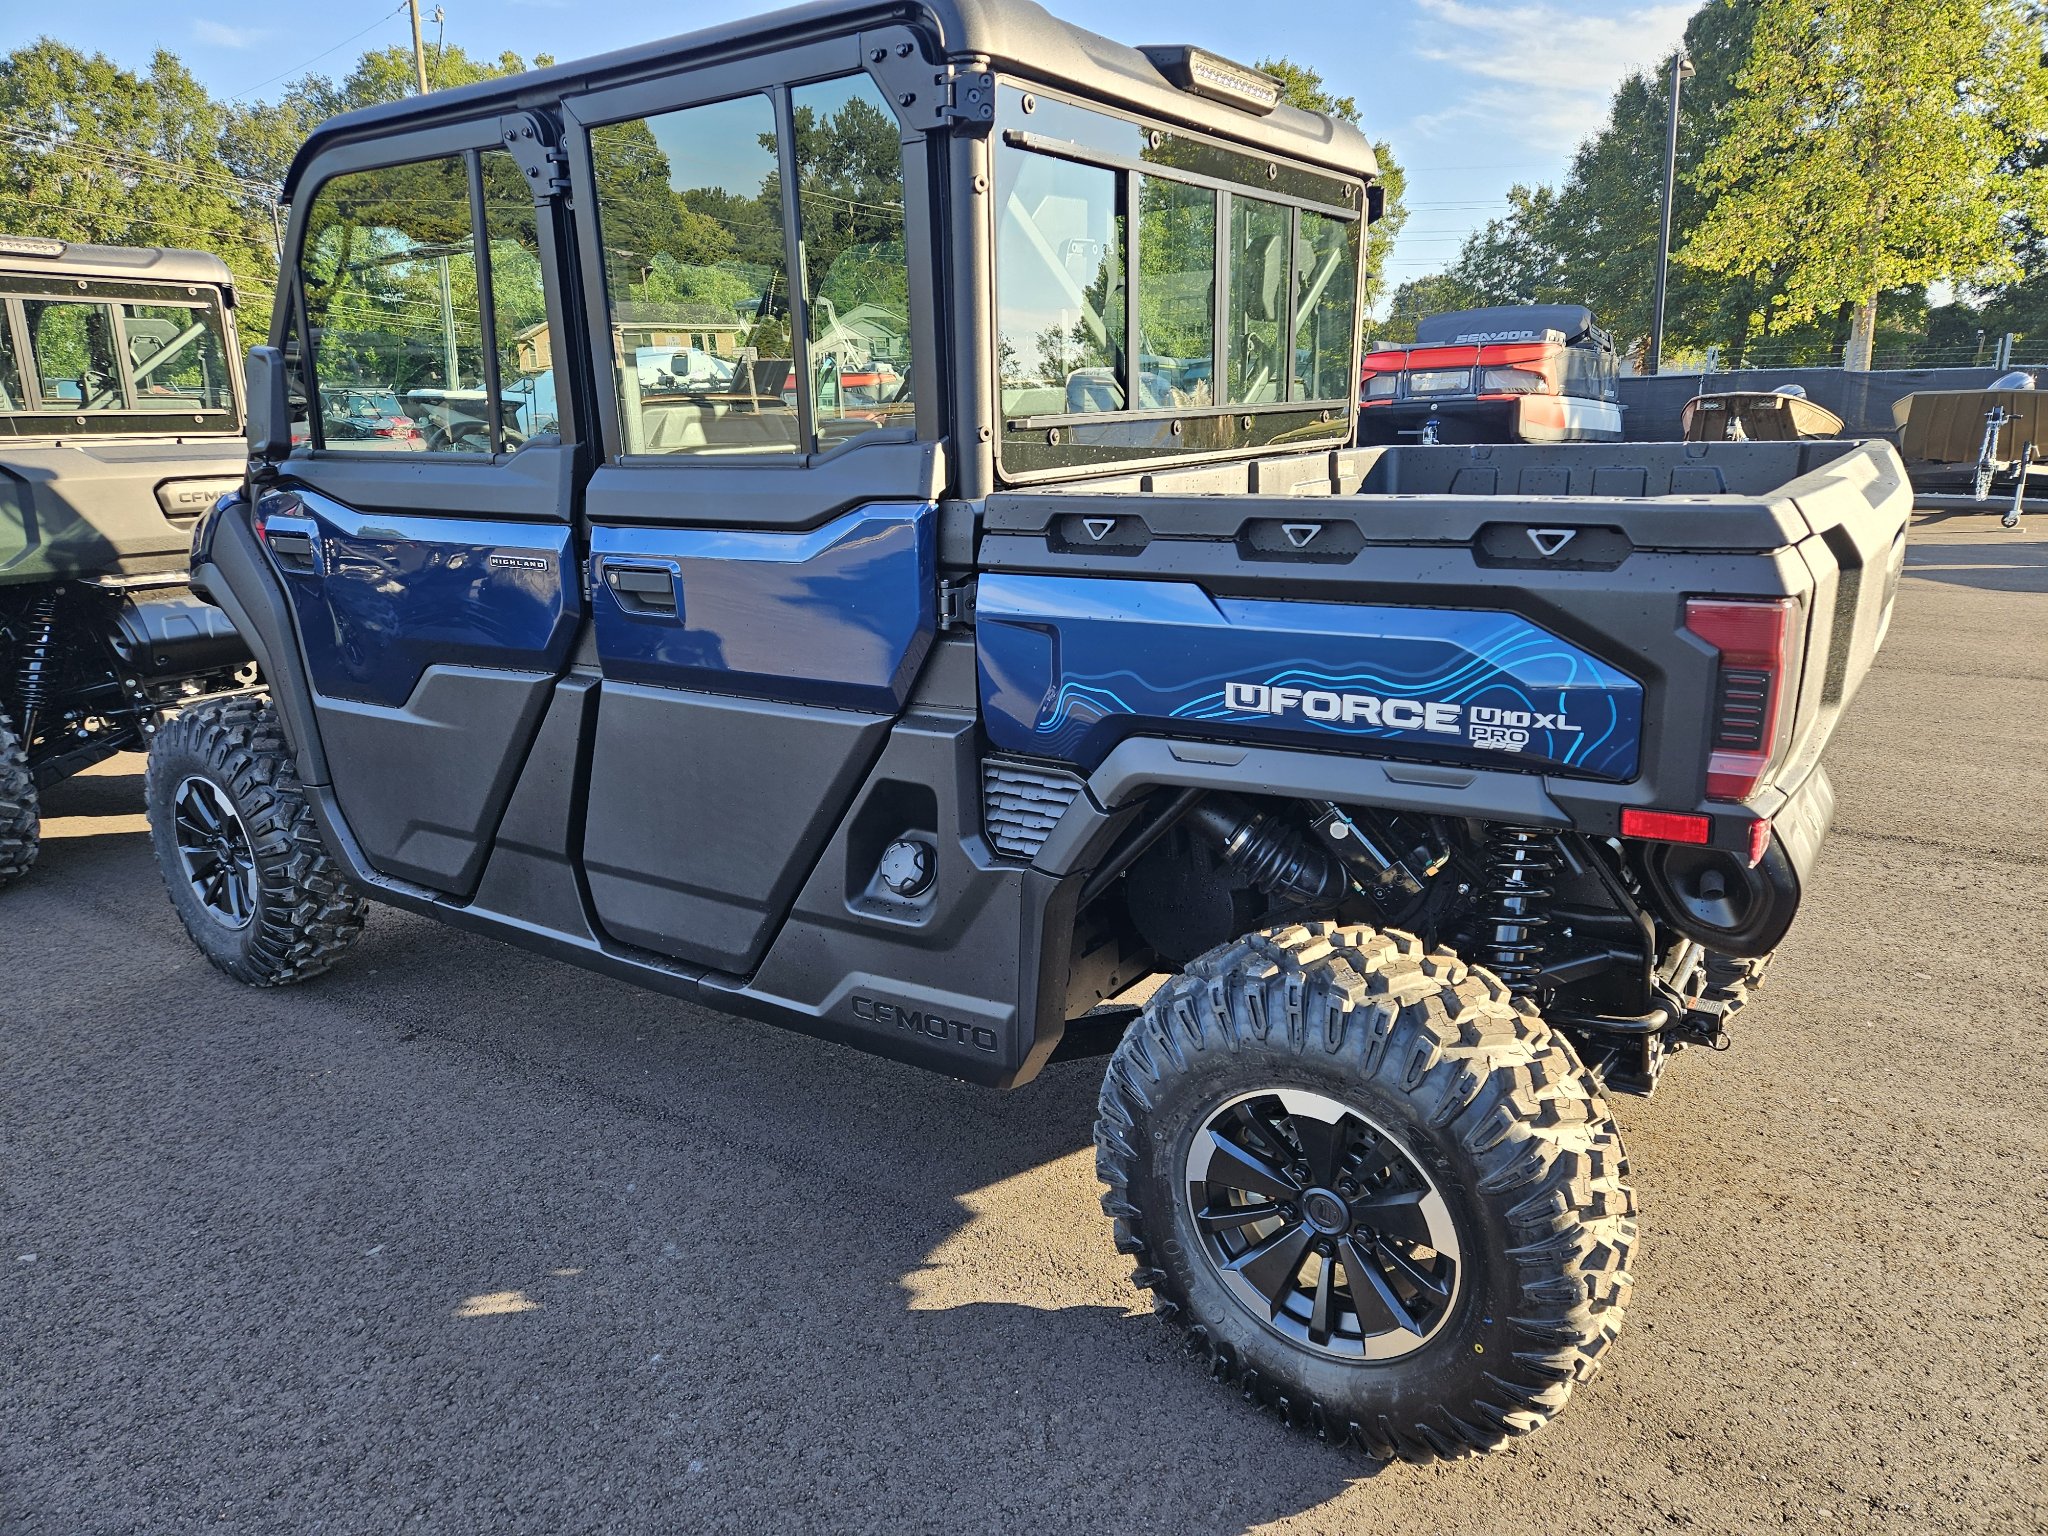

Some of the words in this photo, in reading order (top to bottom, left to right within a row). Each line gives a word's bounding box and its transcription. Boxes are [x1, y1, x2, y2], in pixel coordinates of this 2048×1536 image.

[178, 490, 229, 503] CFM
[492, 558, 544, 568] HIGHLAND
[1468, 724, 1530, 746] PRO
[1473, 739, 1524, 753] EPS
[852, 995, 998, 1052] CFMOTO
